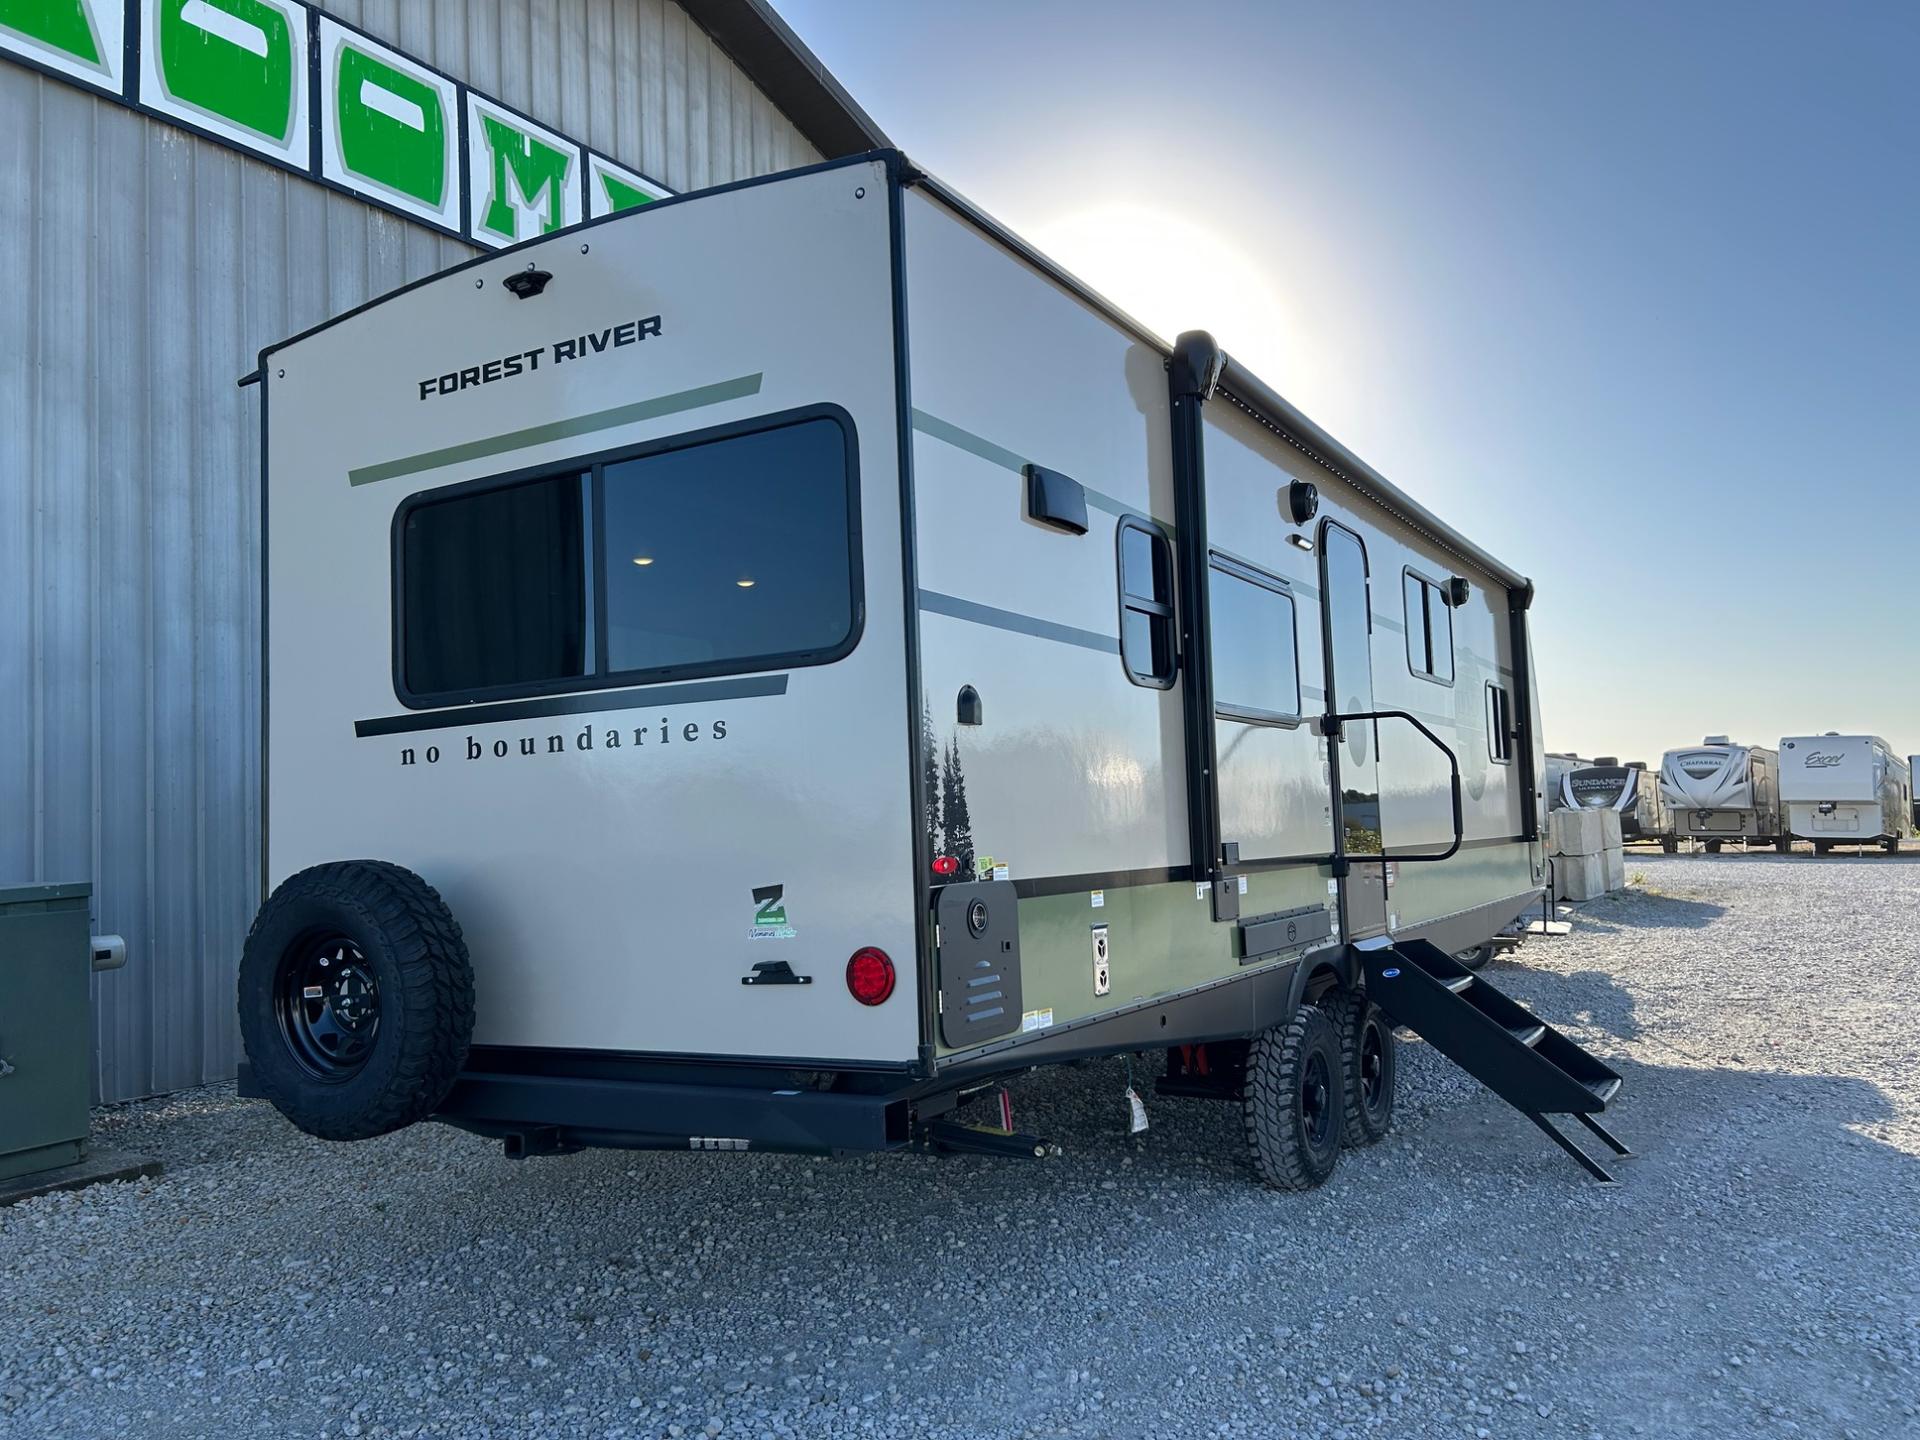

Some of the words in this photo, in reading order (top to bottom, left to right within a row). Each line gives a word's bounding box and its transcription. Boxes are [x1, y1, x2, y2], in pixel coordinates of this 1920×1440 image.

[0, 0, 662, 242] OOM
[418, 347, 545, 400] FOREST
[552, 315, 662, 364] RIVER
[401, 746, 440, 766] no
[466, 717, 727, 760] boundaries
